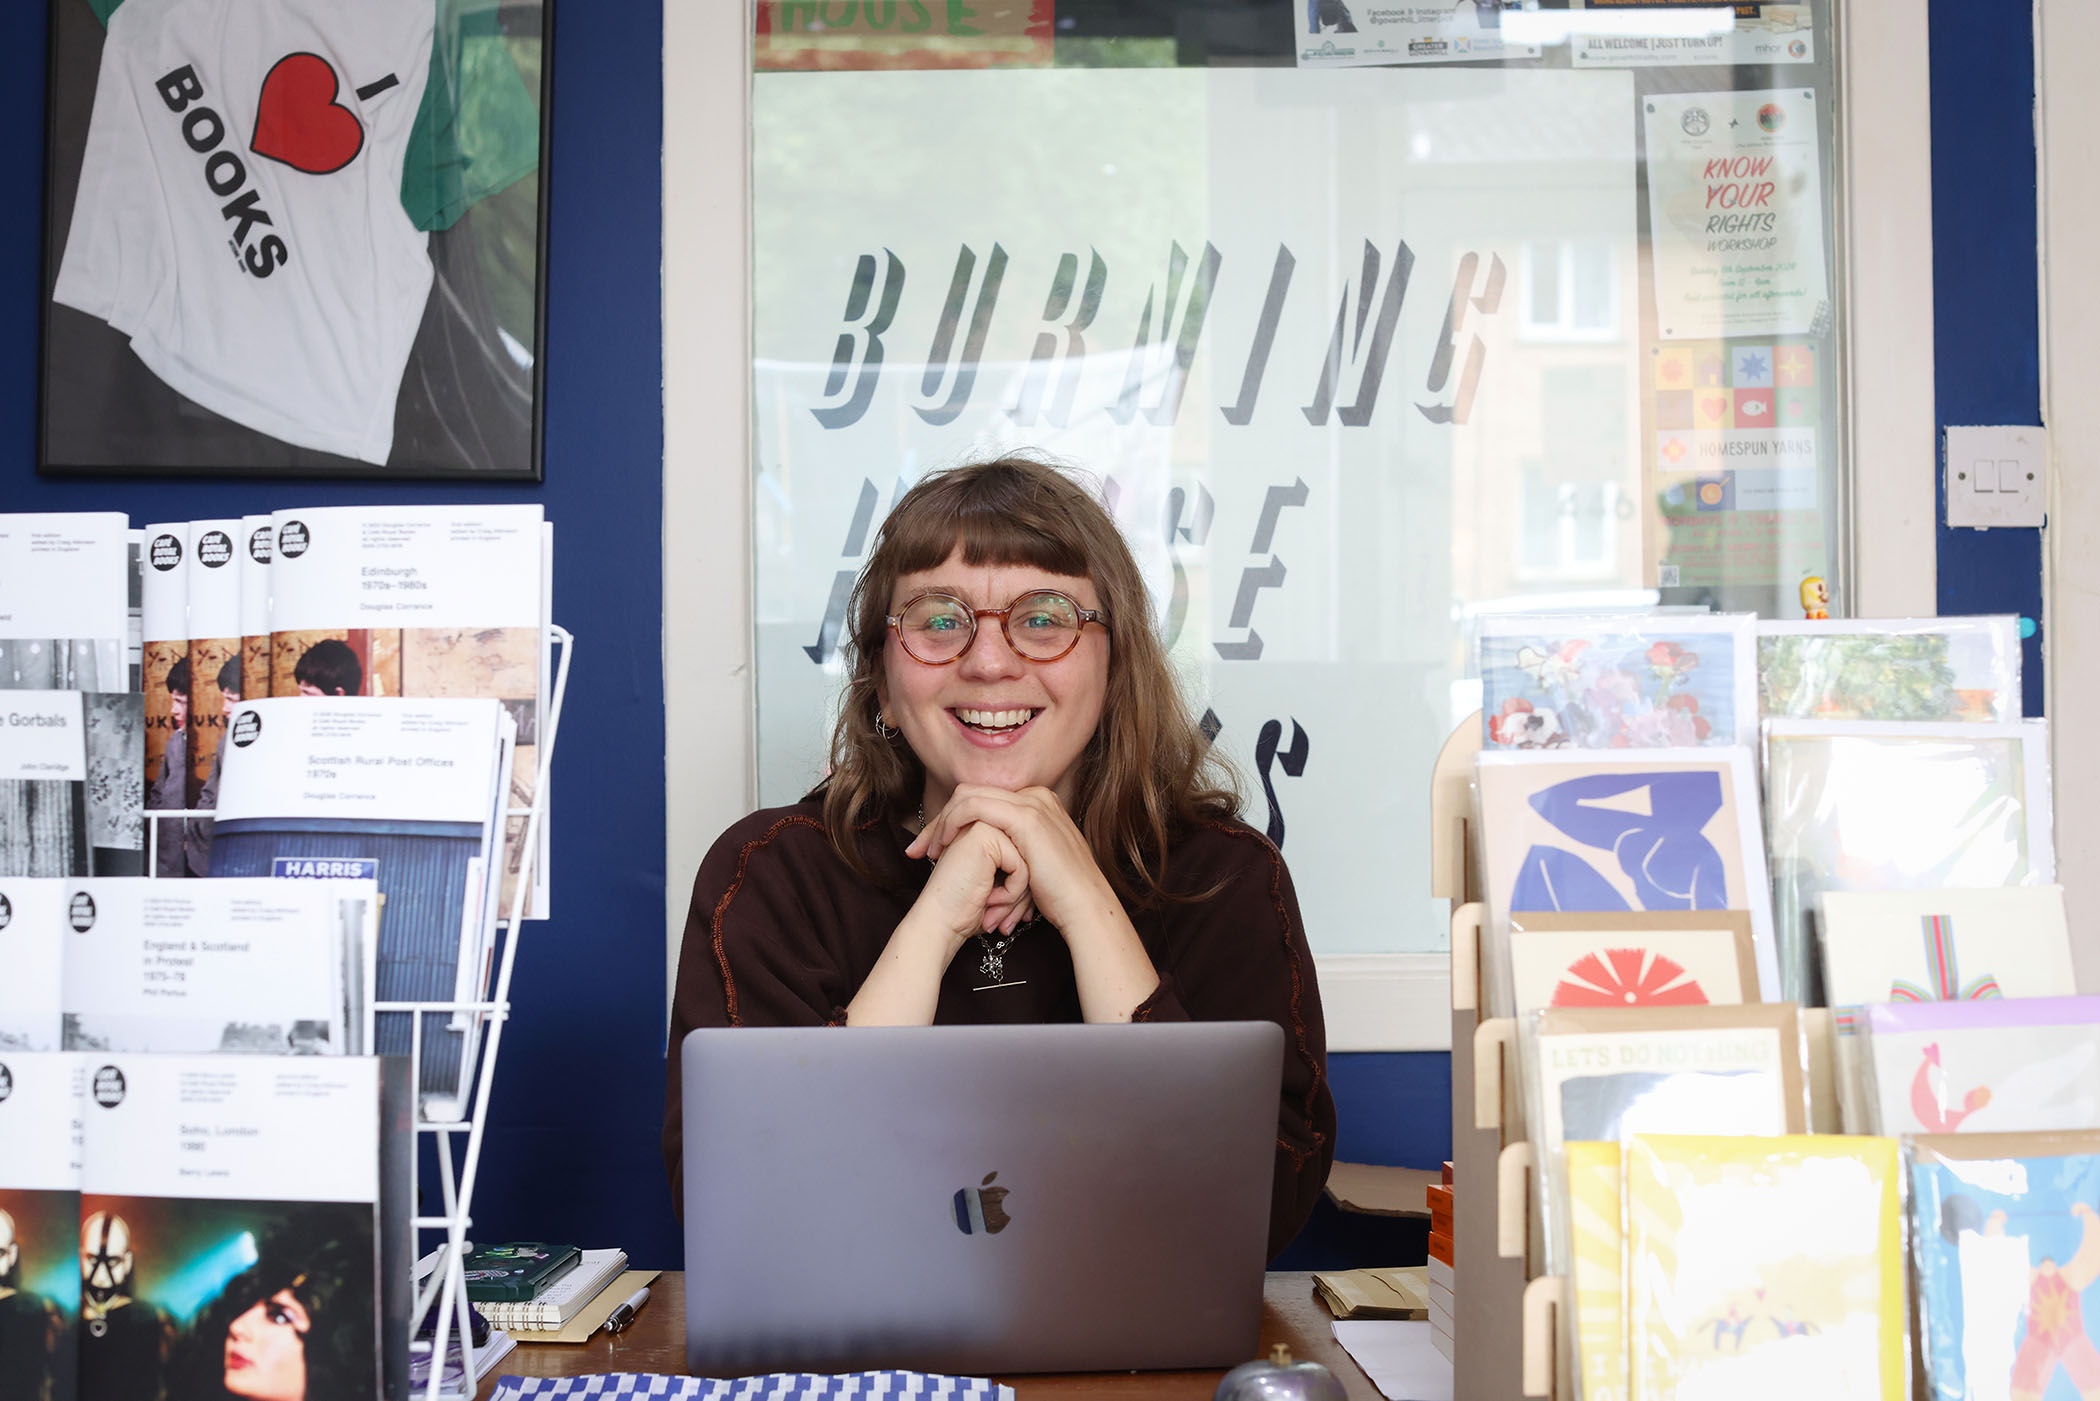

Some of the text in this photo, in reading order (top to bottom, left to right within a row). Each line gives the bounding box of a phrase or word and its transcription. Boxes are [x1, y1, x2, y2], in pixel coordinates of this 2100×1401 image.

[1588, 39, 1603, 50] ALL
[1605, 37, 1648, 49] WELCOME
[1656, 38, 1681, 49] JUST
[1682, 37, 1706, 48] TURN
[155, 64, 288, 278] BOOKS
[1703, 155, 1774, 180] KNOW
[1705, 181, 1775, 209] YOUR
[1705, 212, 1776, 234] RIGHTS
[1707, 236, 1777, 252] WORKSHOP
[810, 237, 1507, 430] BURNING
[1700, 439, 1813, 457] HOMESPUN YARNS
[361, 567, 417, 578] Edinburgh
[360, 602, 393, 611] Douglas
[8, 712, 67, 728] Gorbals
[308, 755, 454, 767] Scottish Rural Post Offices
[285, 861, 362, 877] HARRIS
[143, 940, 187, 952] England
[202, 940, 250, 952] Scotland
[1620, 1044, 1649, 1065] DO
[215, 1126, 259, 1137] London
